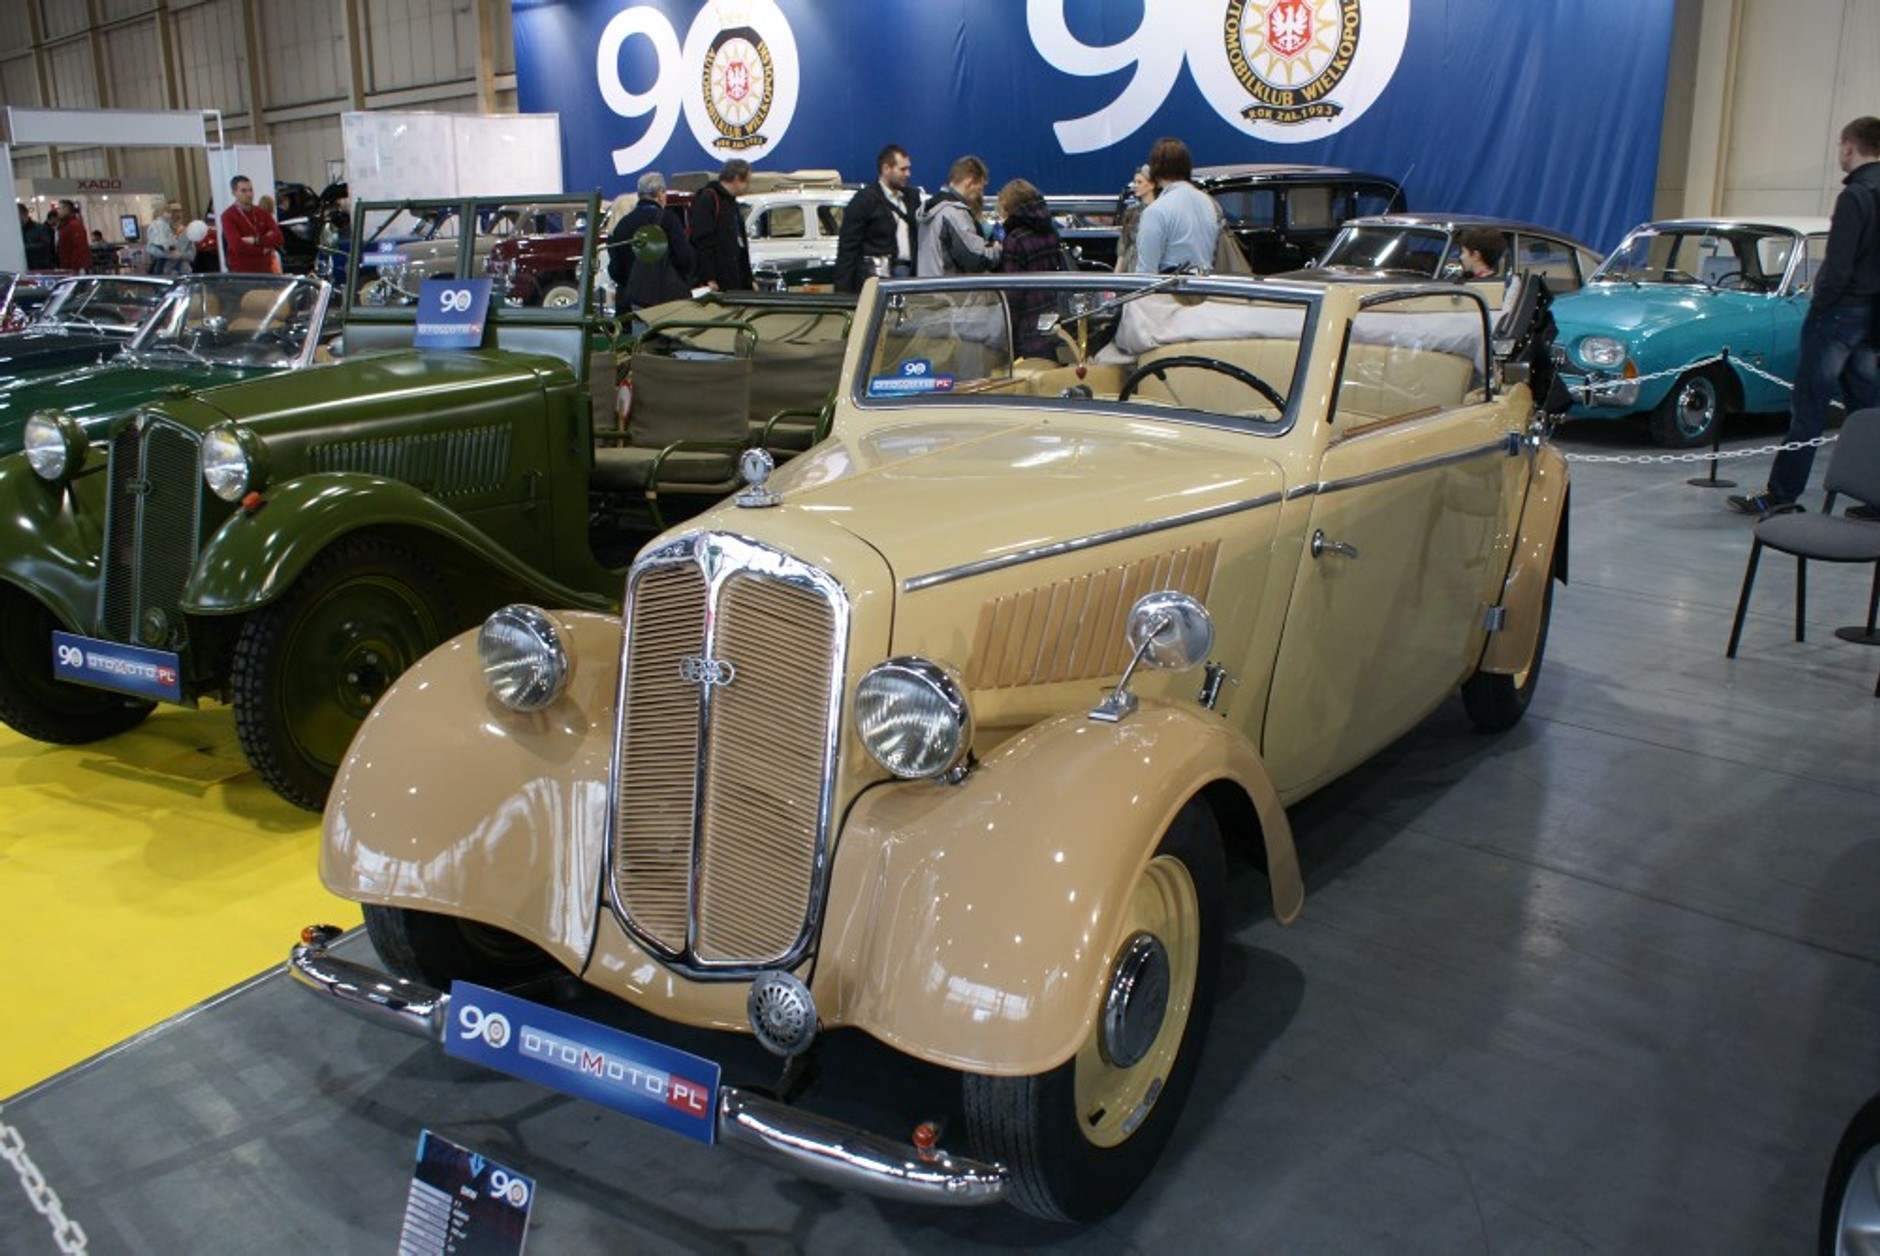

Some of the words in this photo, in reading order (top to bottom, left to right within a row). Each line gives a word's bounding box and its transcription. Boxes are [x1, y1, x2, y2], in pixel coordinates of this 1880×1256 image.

[440, 289, 472, 313] 90
[905, 362, 926, 375] 90
[58, 645, 83, 668] 90
[458, 1004, 511, 1048] 90
[490, 1169, 529, 1208] 90
